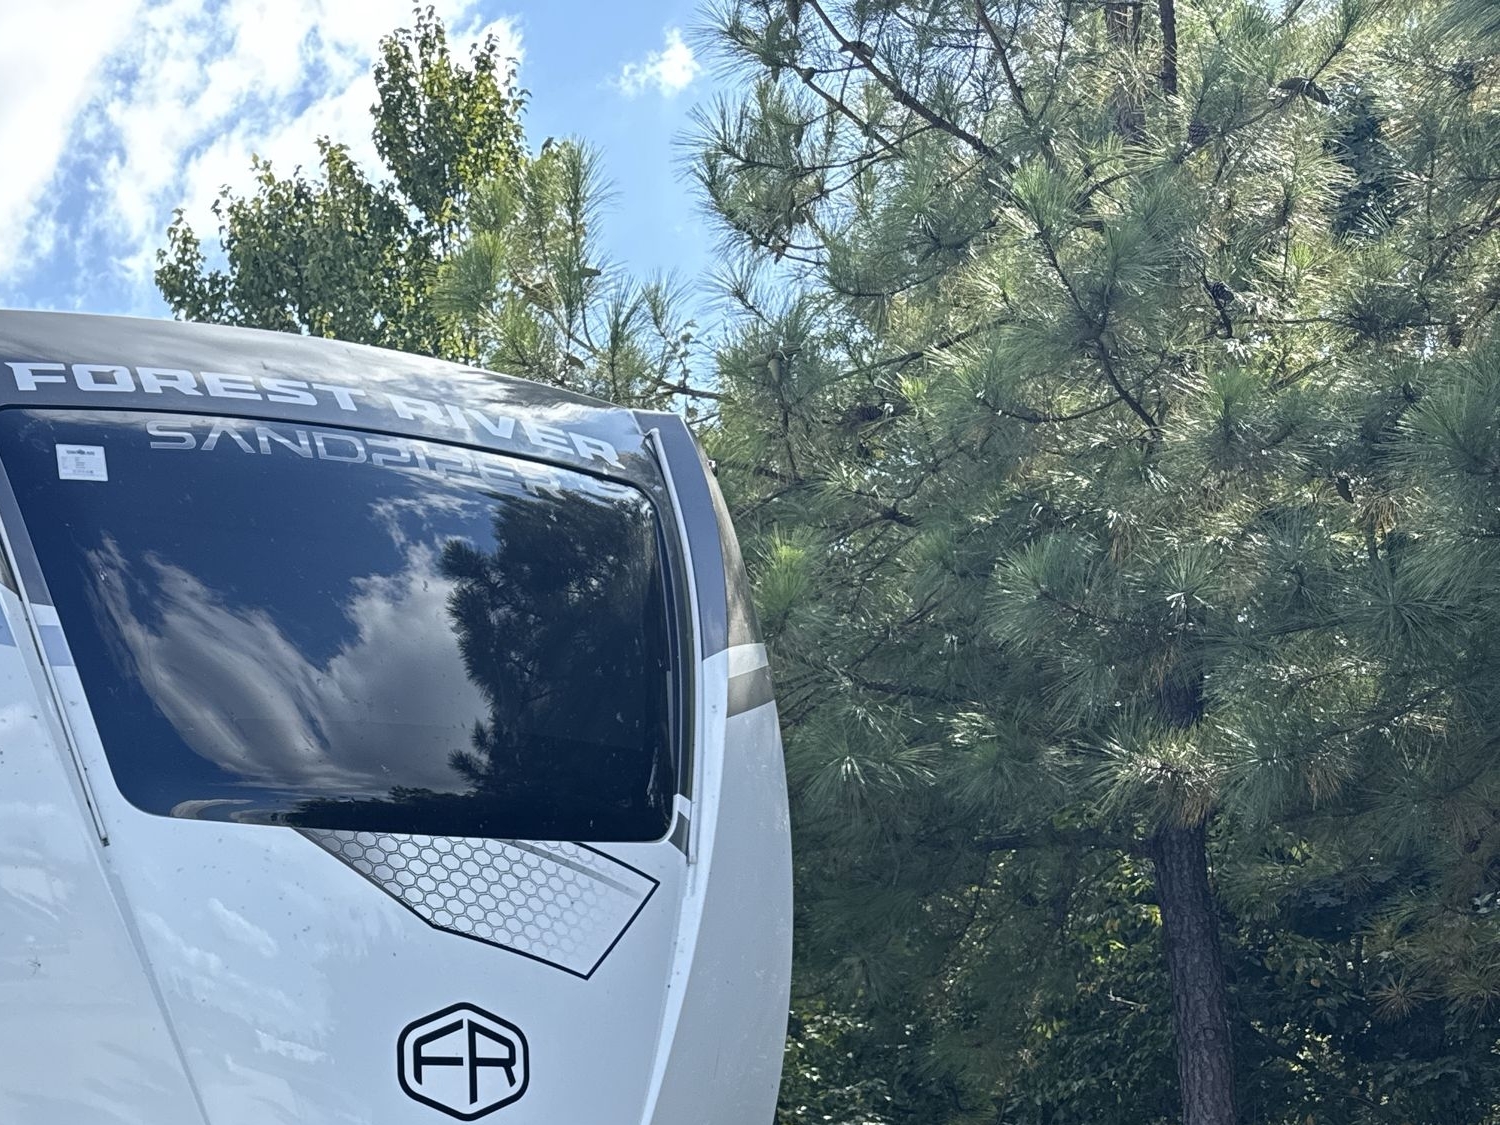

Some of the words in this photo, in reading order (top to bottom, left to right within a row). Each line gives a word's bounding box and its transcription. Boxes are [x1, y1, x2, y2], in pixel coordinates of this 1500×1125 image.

[4, 361, 368, 412] FOREST
[384, 392, 627, 471] RIVER
[145, 419, 568, 501] SANDPIPER
[412, 1017, 517, 1106] FR
